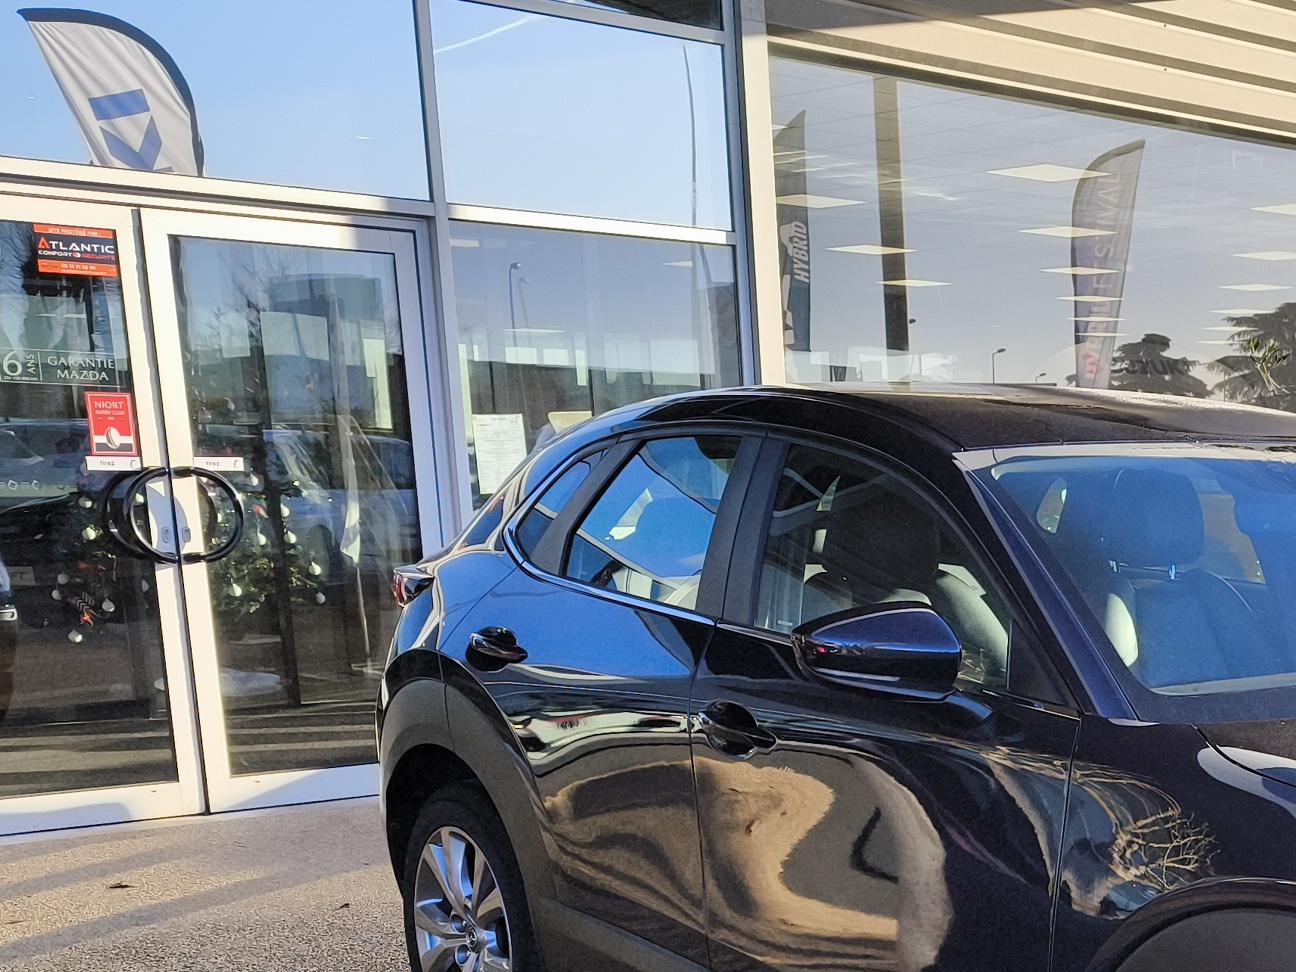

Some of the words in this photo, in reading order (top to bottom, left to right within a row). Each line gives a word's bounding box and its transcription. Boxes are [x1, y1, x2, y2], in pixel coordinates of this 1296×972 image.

[37, 236, 115, 253] ATLANTIC
[792, 220, 810, 283] HYBRID
[2, 350, 23, 376] 6
[25, 354, 37, 375] ANS
[47, 355, 116, 369] GARANTIE
[56, 369, 110, 381] MAZDA
[94, 401, 124, 409] NIORT
